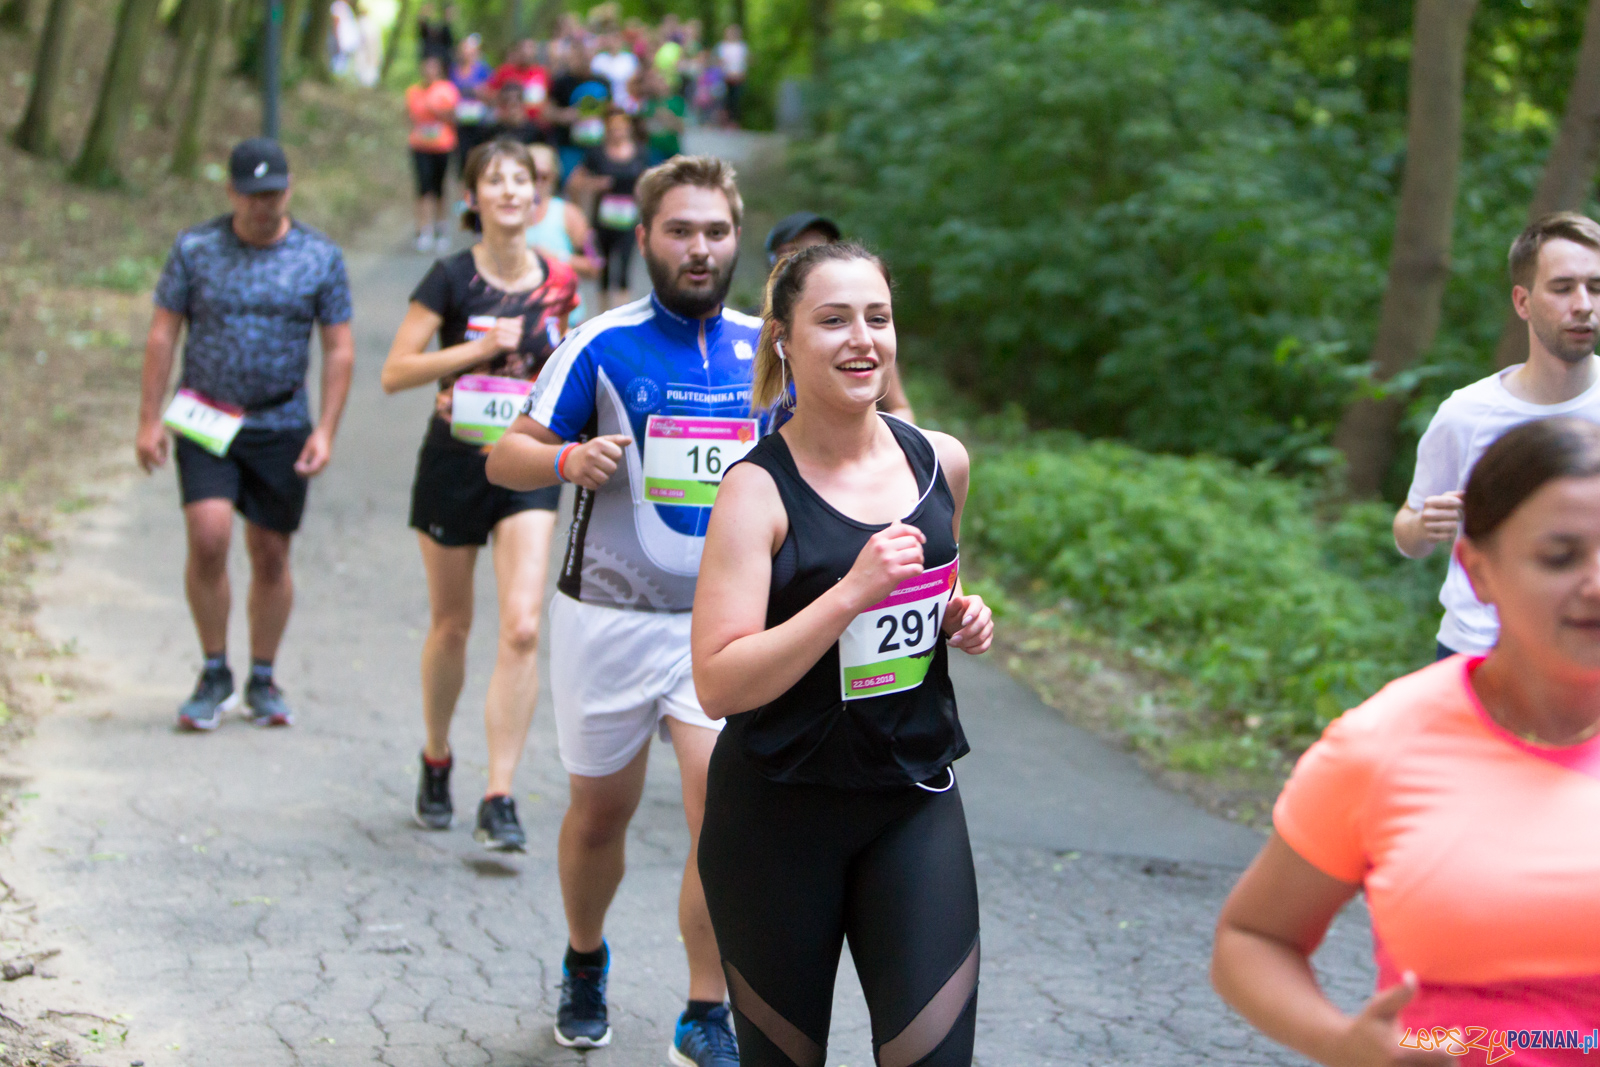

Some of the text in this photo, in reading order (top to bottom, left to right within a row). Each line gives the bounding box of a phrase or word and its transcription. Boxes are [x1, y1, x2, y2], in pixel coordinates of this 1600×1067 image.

[666, 390, 734, 402] POLITECHNIKA
[483, 400, 513, 420] 40
[687, 446, 721, 474] 16
[876, 602, 939, 654] 291
[852, 674, 895, 689] 22.06.2018
